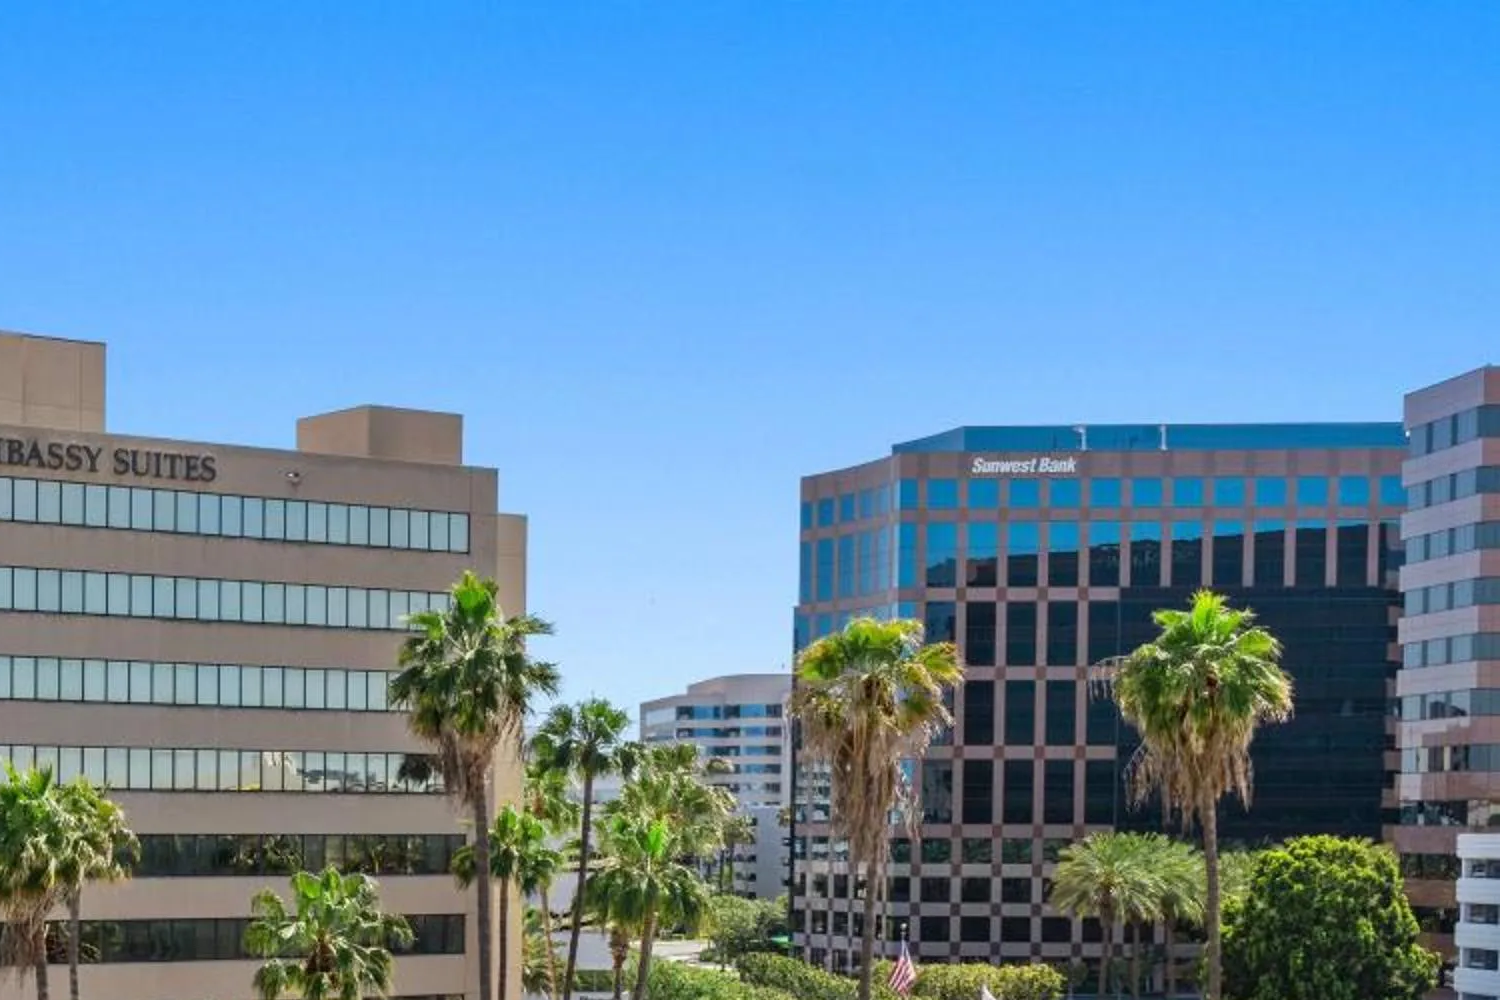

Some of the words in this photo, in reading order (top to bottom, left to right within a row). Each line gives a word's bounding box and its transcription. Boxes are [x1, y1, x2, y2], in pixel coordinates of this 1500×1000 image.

[112, 448, 217, 482] SUITES
[971, 456, 1038, 473] Sunwest
[1039, 456, 1077, 473] Bank
